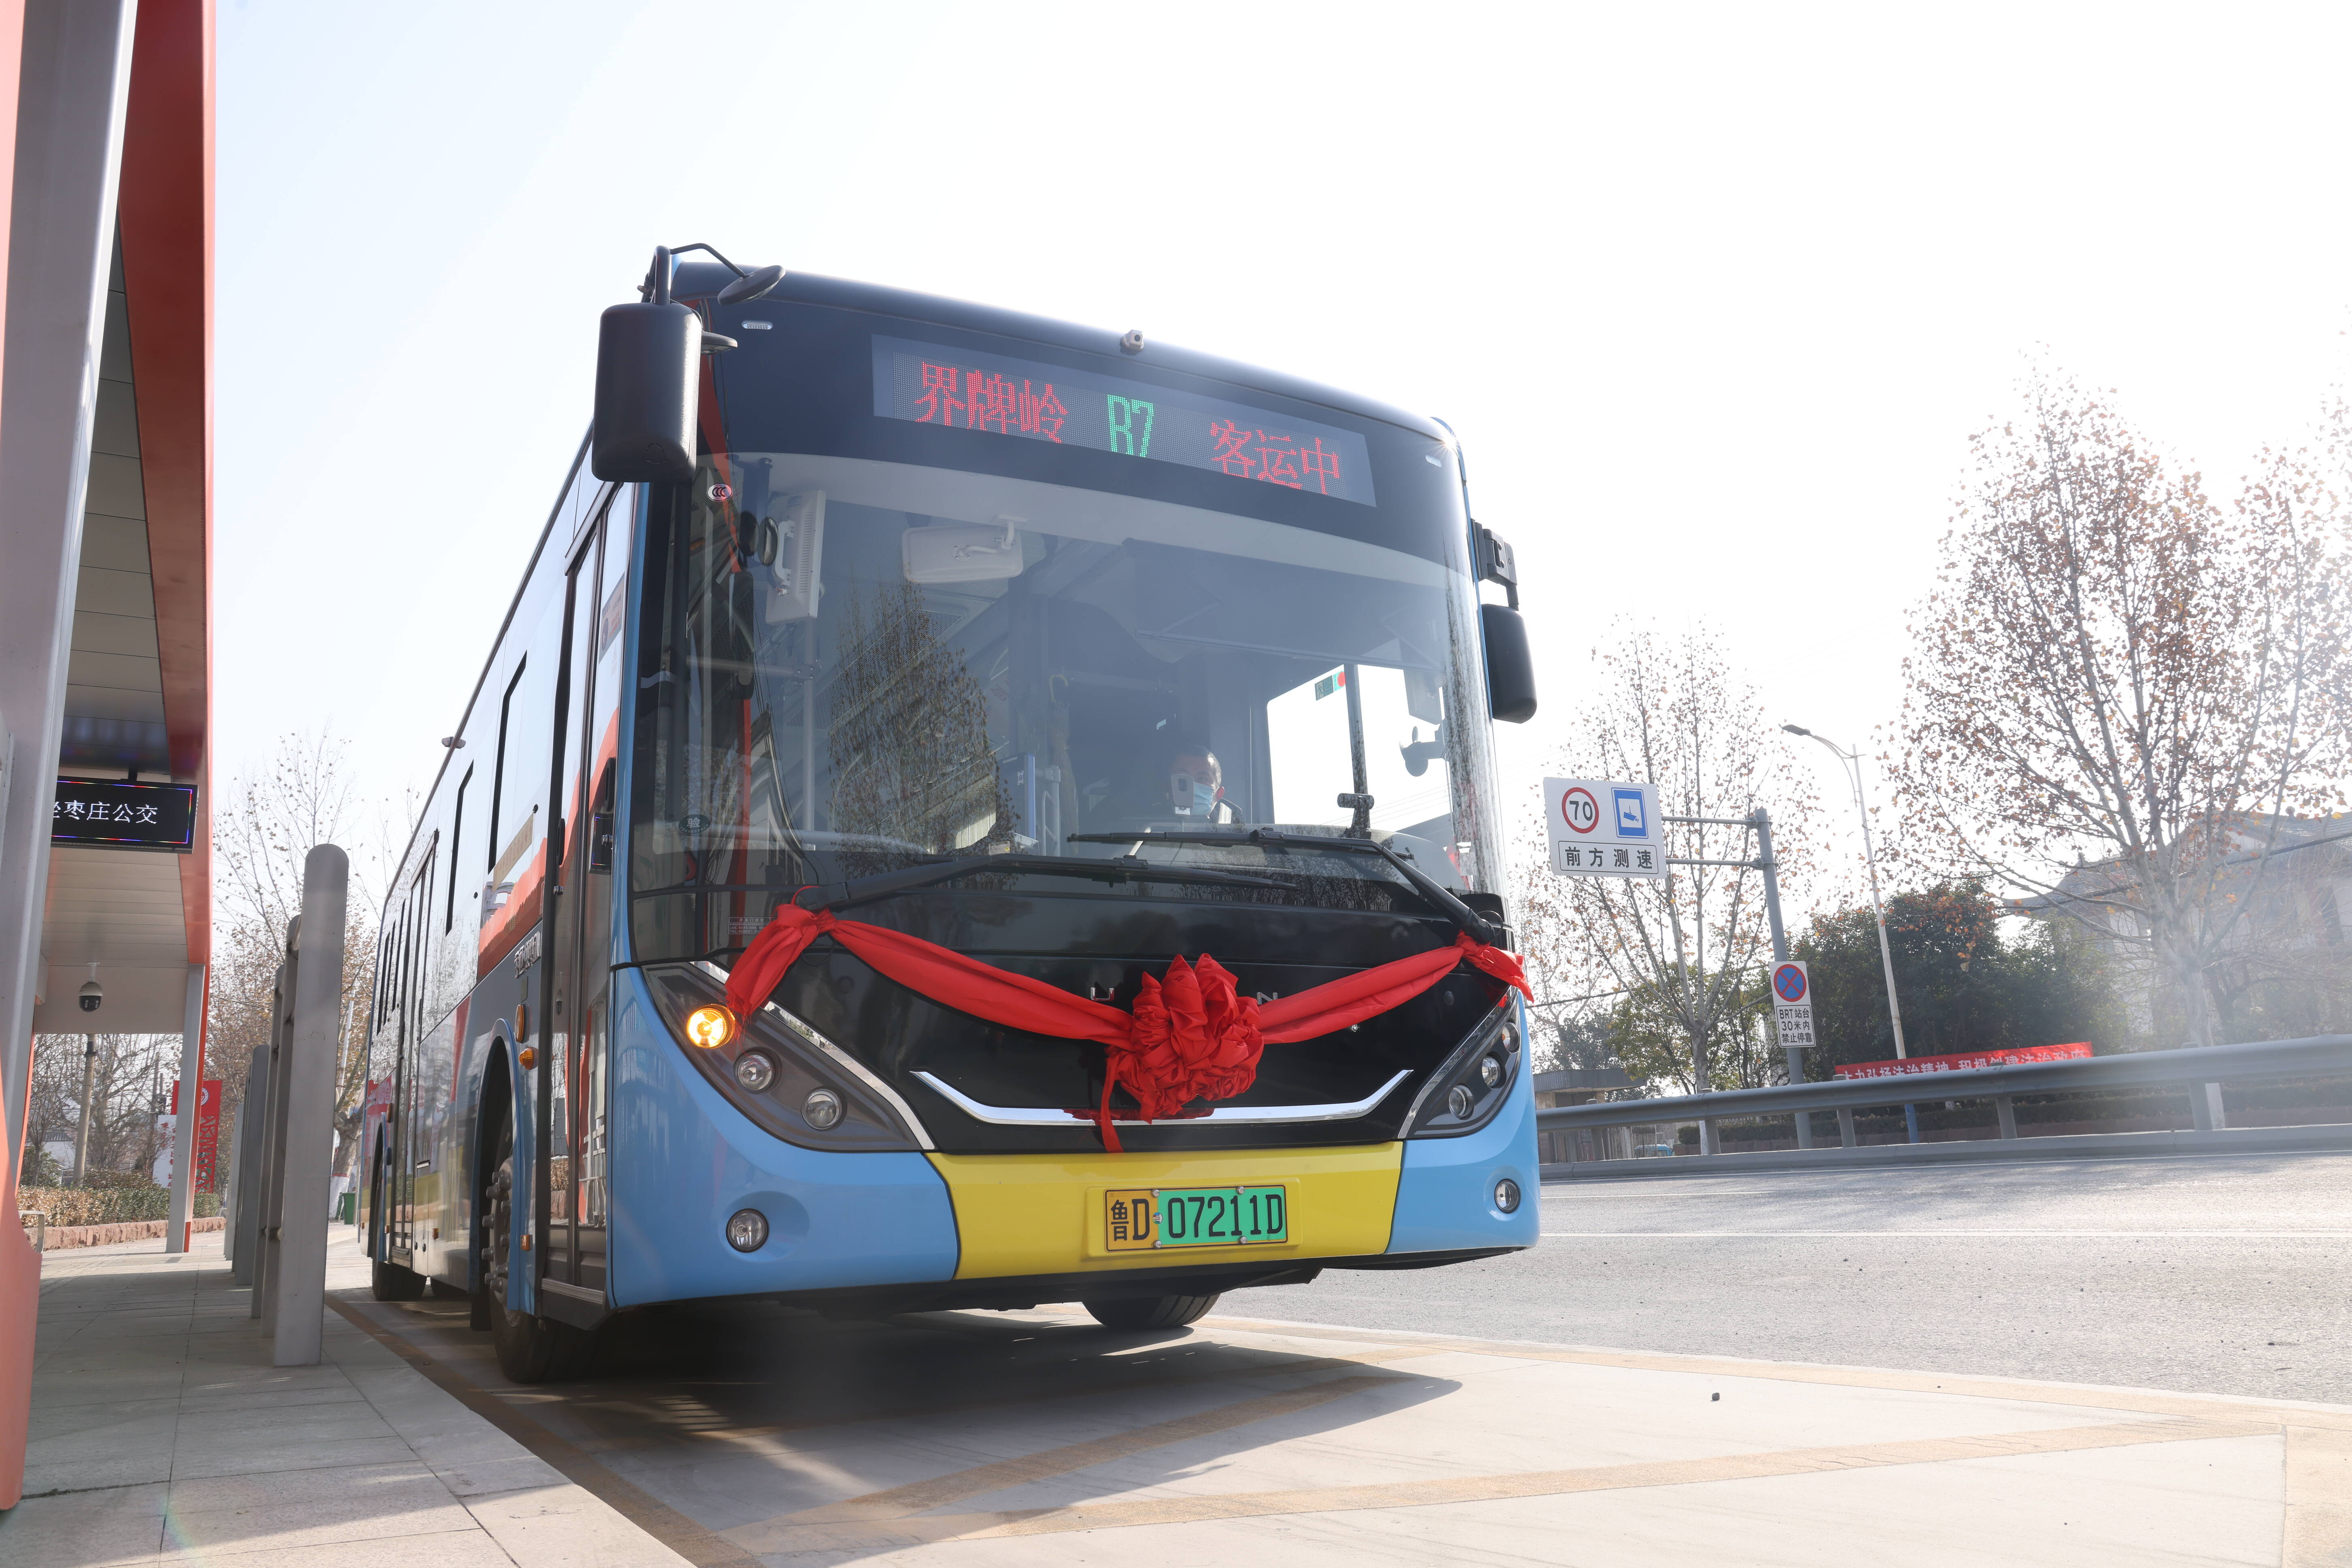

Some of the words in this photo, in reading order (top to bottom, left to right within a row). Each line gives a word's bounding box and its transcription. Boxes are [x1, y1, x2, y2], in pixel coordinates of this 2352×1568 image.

[915, 361, 1068, 444] 界牌岭
[1107, 394, 1155, 458] R7
[1210, 419, 1340, 495] 客运中
[1569, 801, 1593, 821] 70
[687, 817, 701, 828] 验
[1565, 846, 1653, 869] 前方测速
[1781, 1020, 1810, 1031] 30米内
[1781, 1032, 1813, 1044] 禁止停靠
